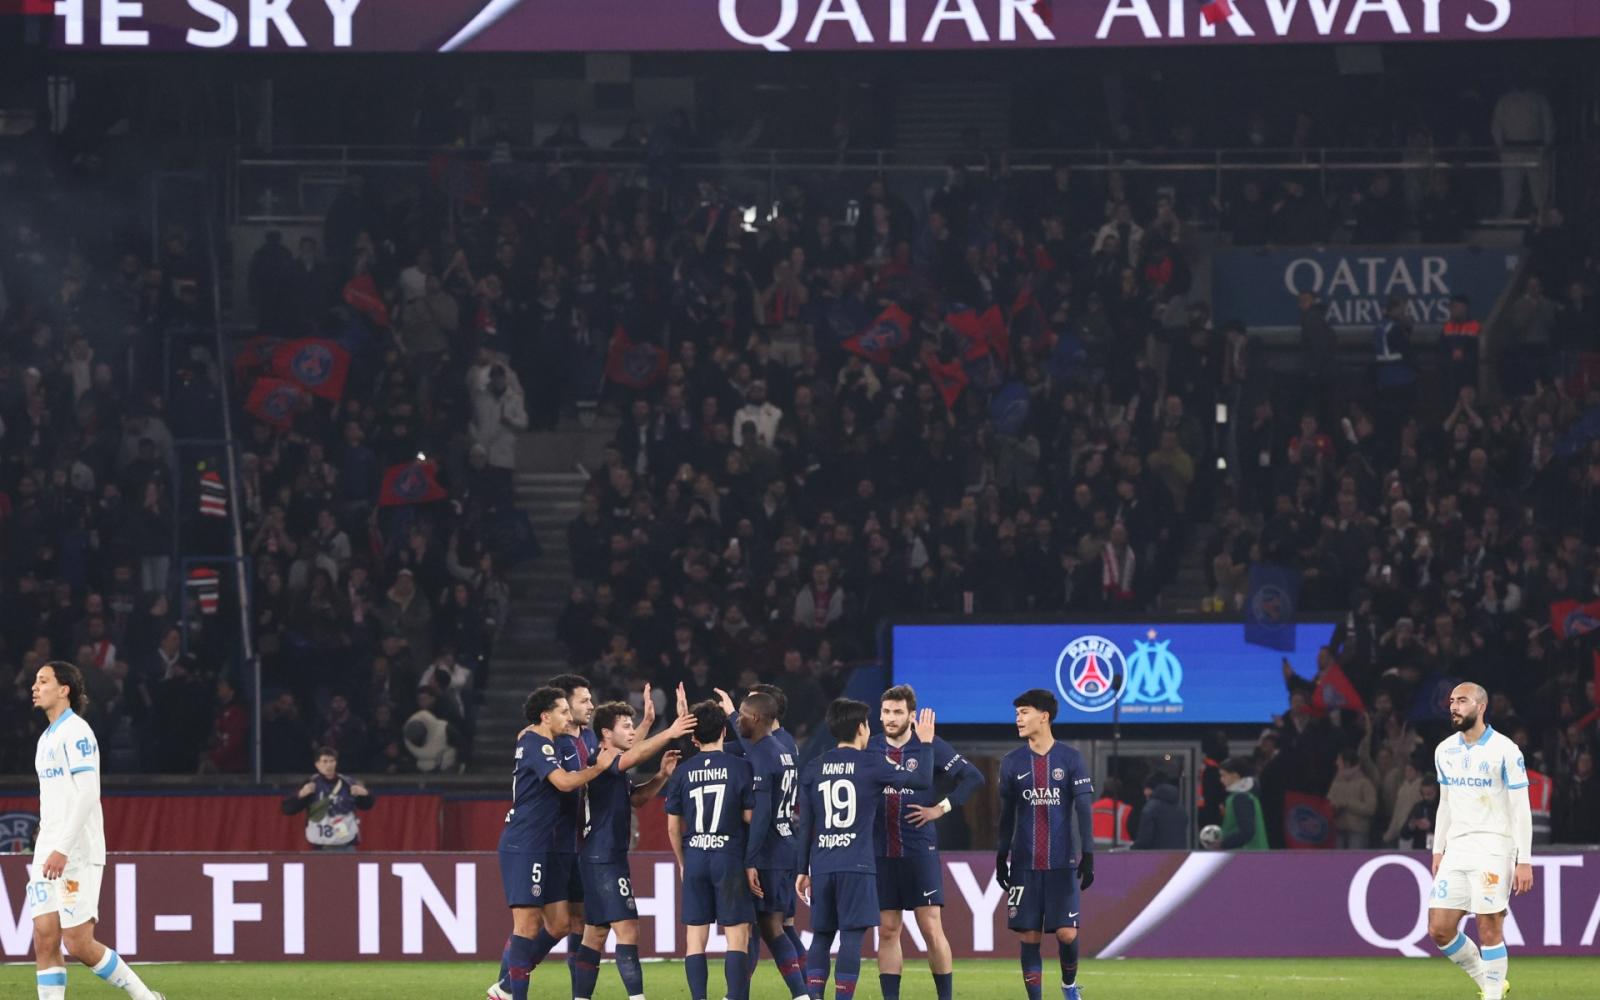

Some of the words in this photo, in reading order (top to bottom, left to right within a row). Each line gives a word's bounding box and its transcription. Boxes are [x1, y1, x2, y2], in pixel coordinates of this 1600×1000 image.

[1284, 257, 1450, 297] QATAR
[1325, 299, 1451, 322] AIRAYS
[1067, 640, 1115, 659] PARIS
[688, 768, 728, 782] VITINHA
[822, 763, 844, 774] KANG
[845, 762, 854, 774] IN
[1467, 778, 1492, 787] CGM
[1022, 787, 1061, 800] QATAR
[689, 784, 726, 833] 17
[818, 779, 857, 829] 19
[532, 863, 542, 883] 5
[27, 881, 48, 909] 26
[617, 877, 634, 897] 8
[1008, 886, 1024, 906] 27
[358, 862, 477, 954] IN
